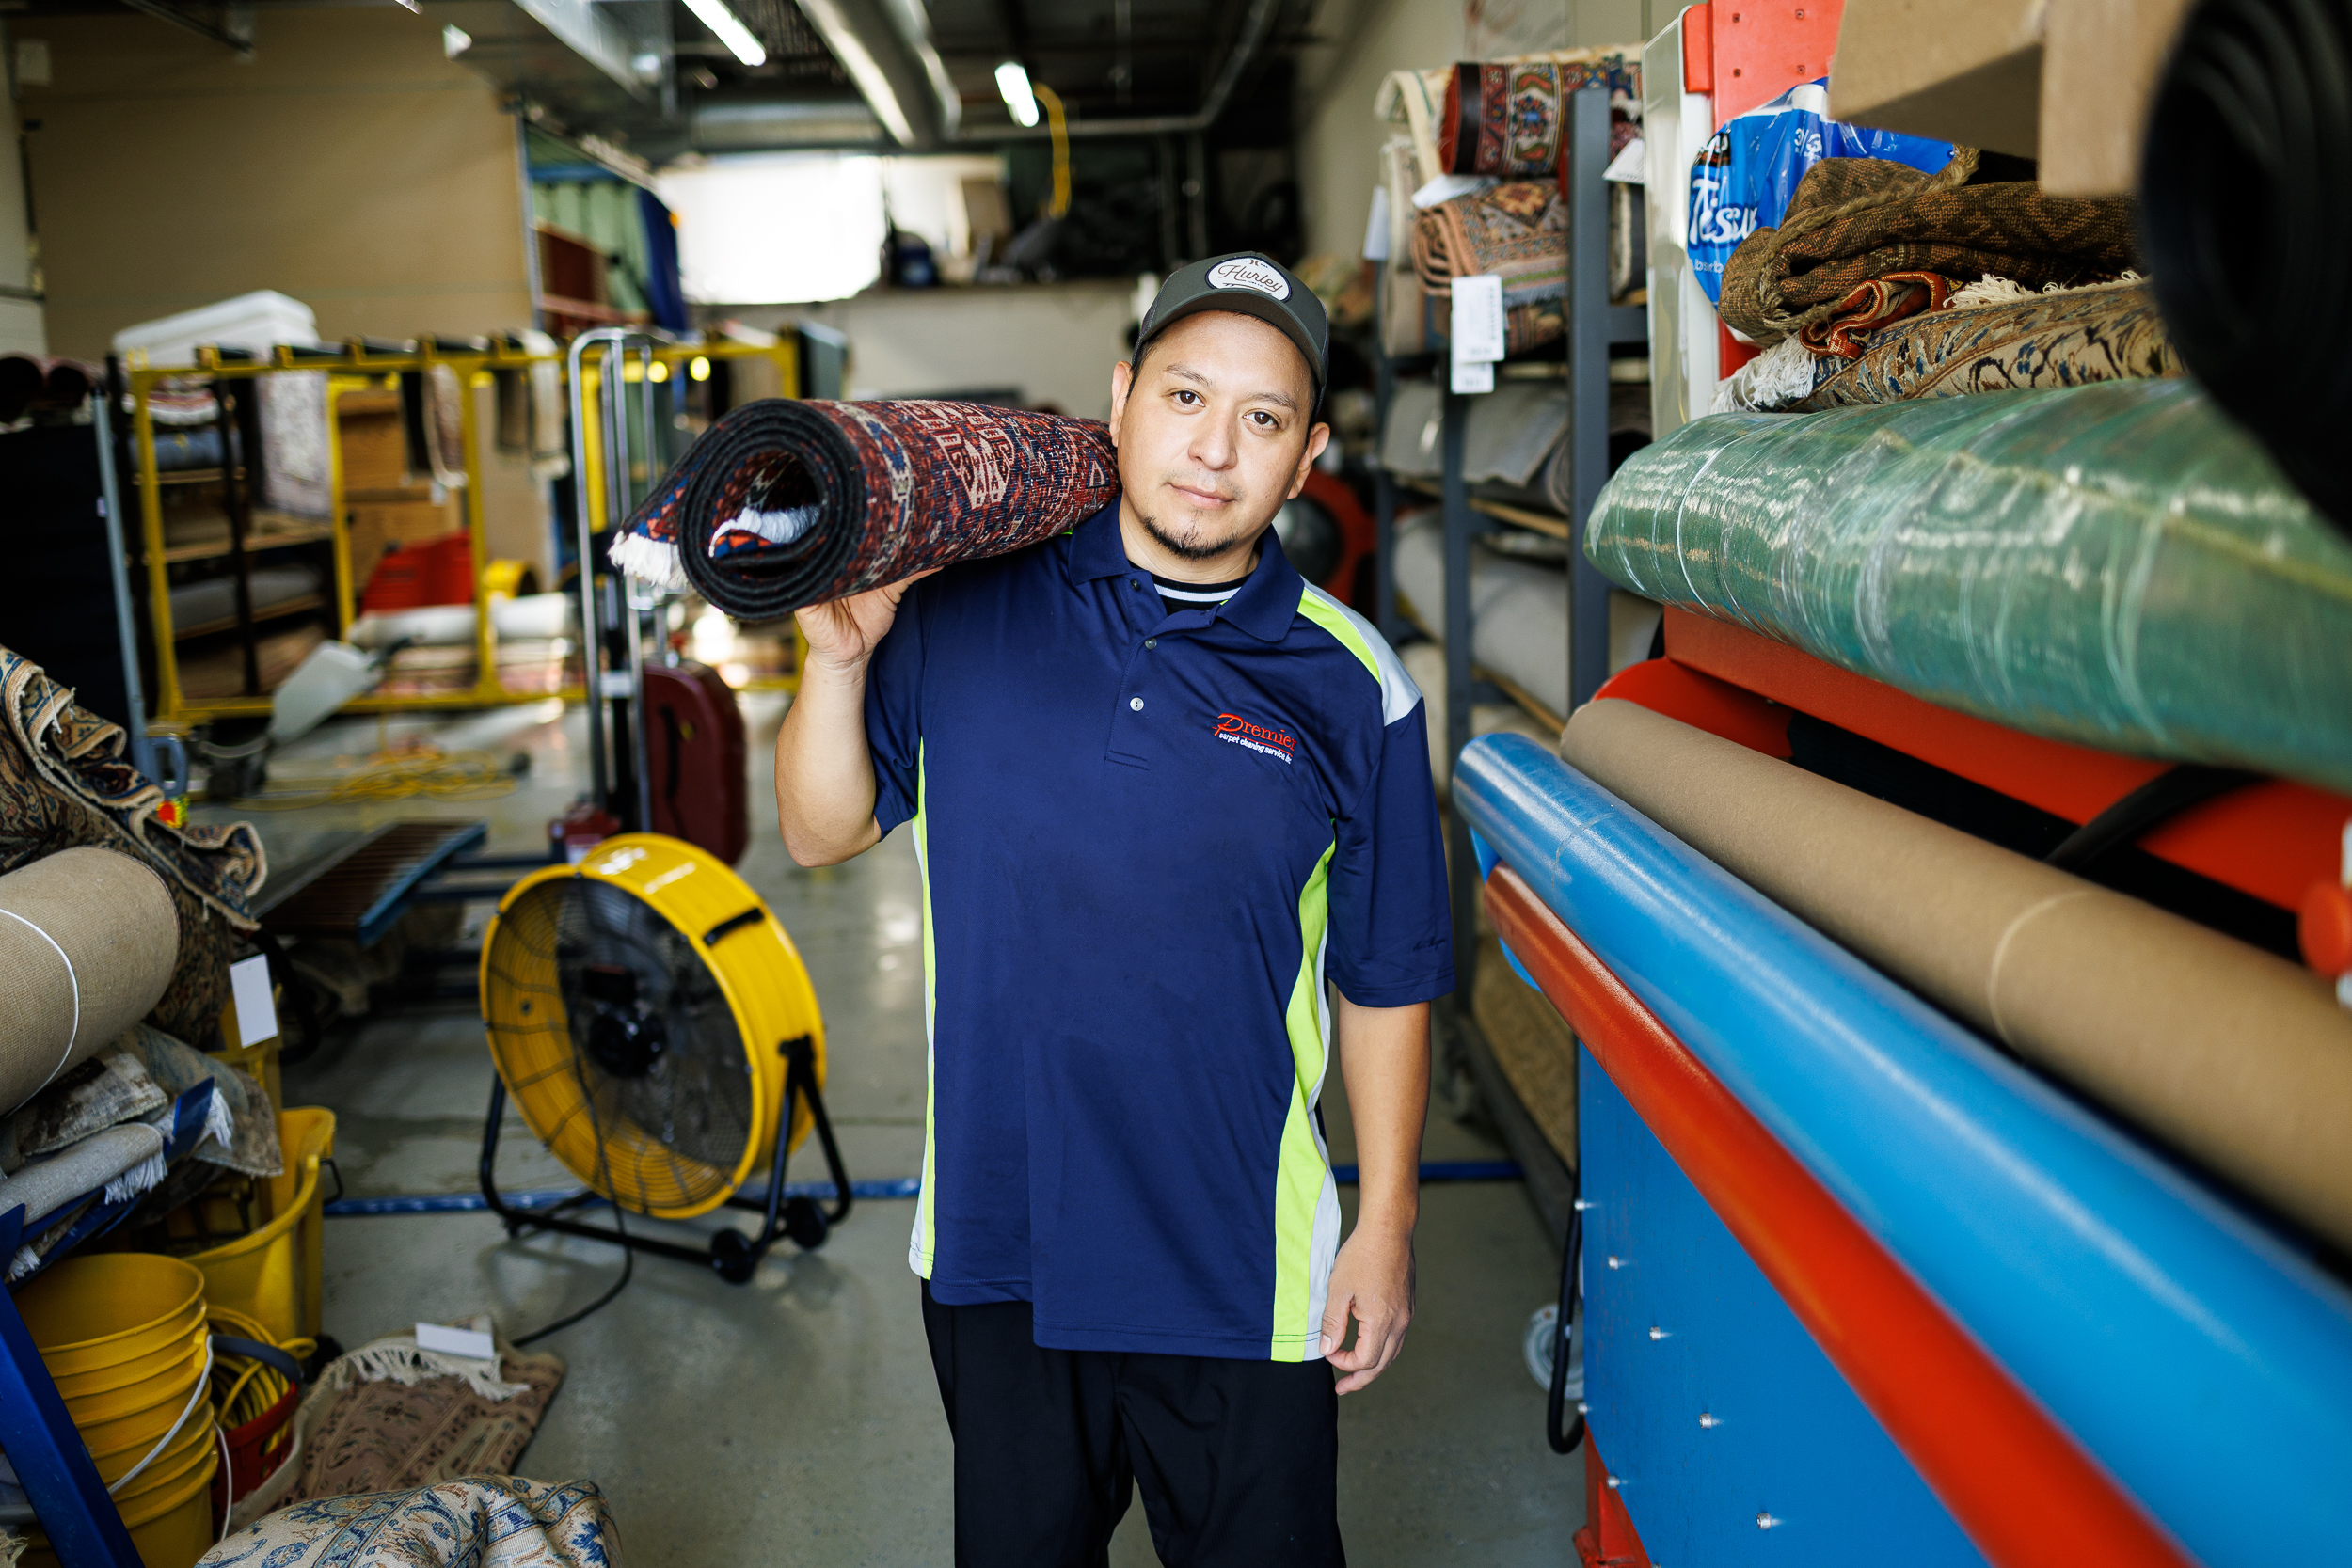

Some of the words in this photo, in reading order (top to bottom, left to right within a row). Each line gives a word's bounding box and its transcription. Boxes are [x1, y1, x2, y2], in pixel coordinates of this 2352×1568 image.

[1217, 264, 1283, 293] Hurley
[1212, 712, 1297, 752] Premier
[1218, 732, 1240, 744] carpet
[1239, 737, 1265, 754] cleaning
